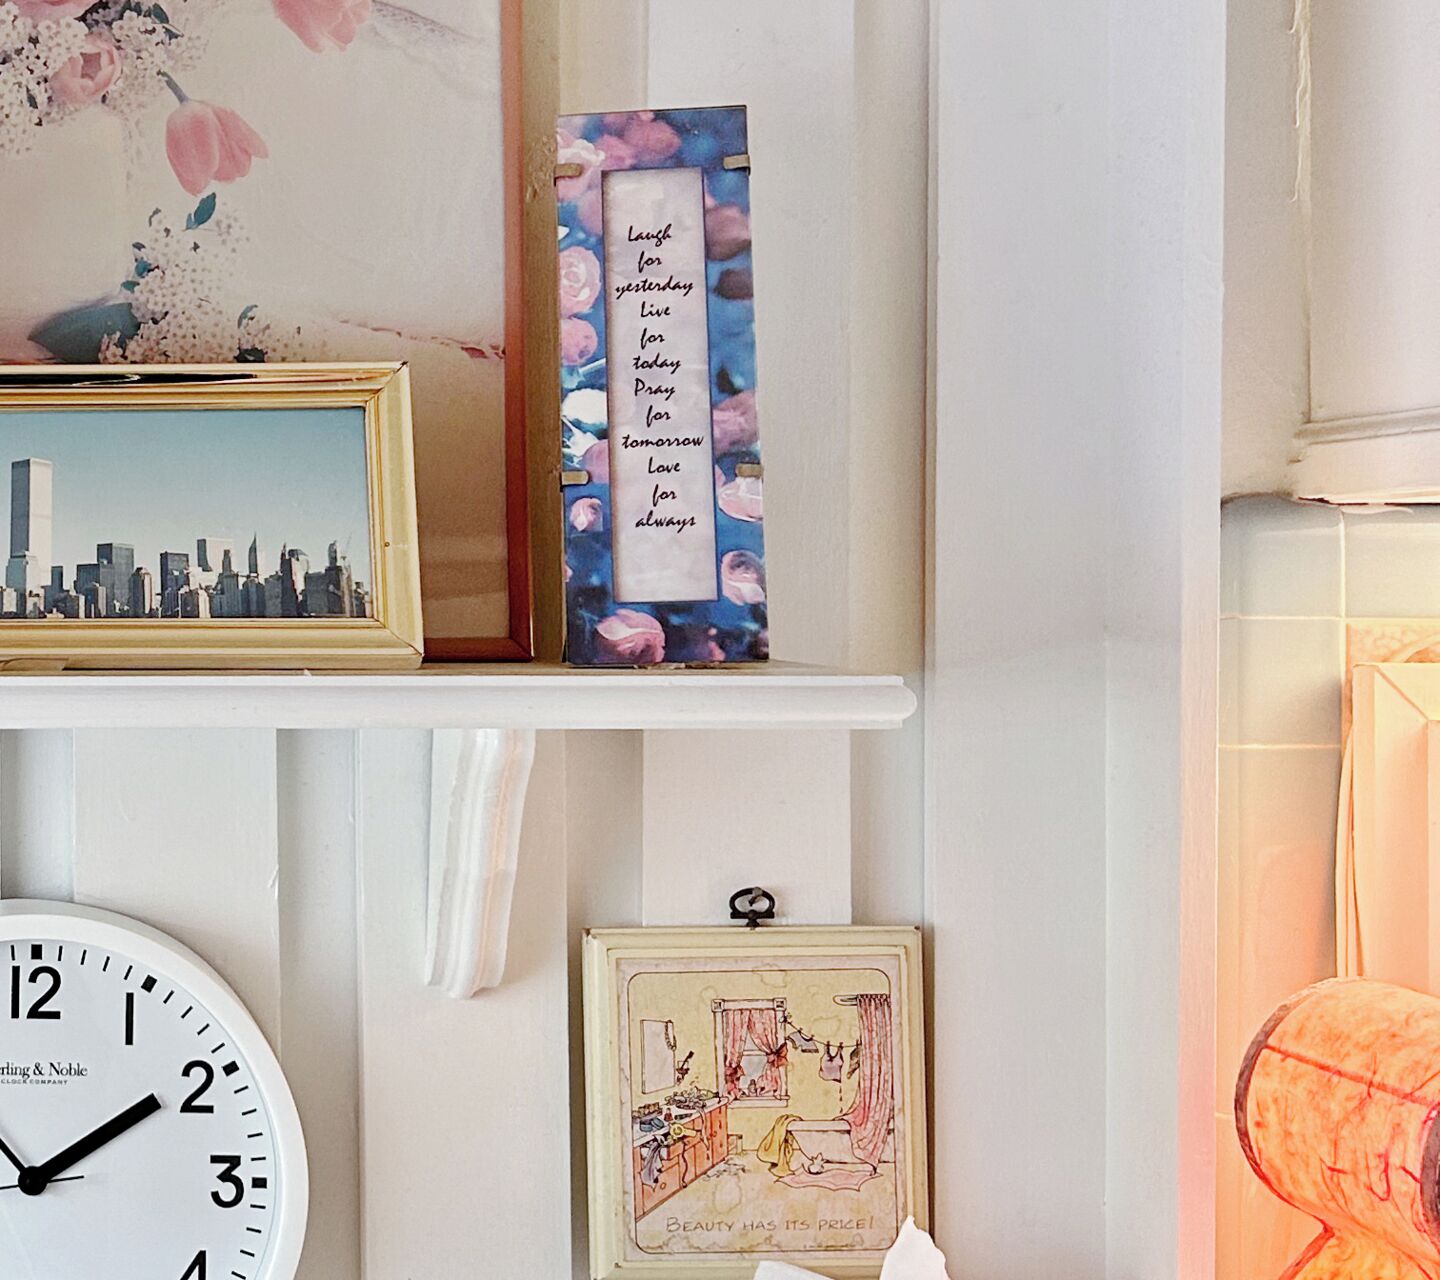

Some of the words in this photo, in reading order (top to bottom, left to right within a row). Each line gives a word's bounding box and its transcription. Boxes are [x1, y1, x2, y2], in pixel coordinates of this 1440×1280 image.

[627, 223, 672, 248] Laugh
[637, 250, 663, 274] for
[615, 275, 694, 300] yesterday
[640, 301, 671, 319] Live
[640, 326, 665, 350] for
[633, 352, 681, 375] today
[634, 377, 676, 401] Pray
[646, 403, 671, 428] for
[622, 434, 705, 450] tomorrow
[648, 456, 680, 475] Love
[652, 483, 678, 508] for
[635, 510, 697, 534] always
[10, 965, 62, 1020] 12
[124, 991, 135, 1046] 1
[32, 1062, 45, 1076] &
[48, 1061, 88, 1077] Noble
[179, 1058, 216, 1115] 2
[209, 1154, 246, 1209] 3
[666, 1216, 734, 1233] BEAUTY
[743, 1220, 777, 1232] HAS
[785, 1219, 810, 1231] ITS
[818, 1215, 874, 1231] PRICE!
